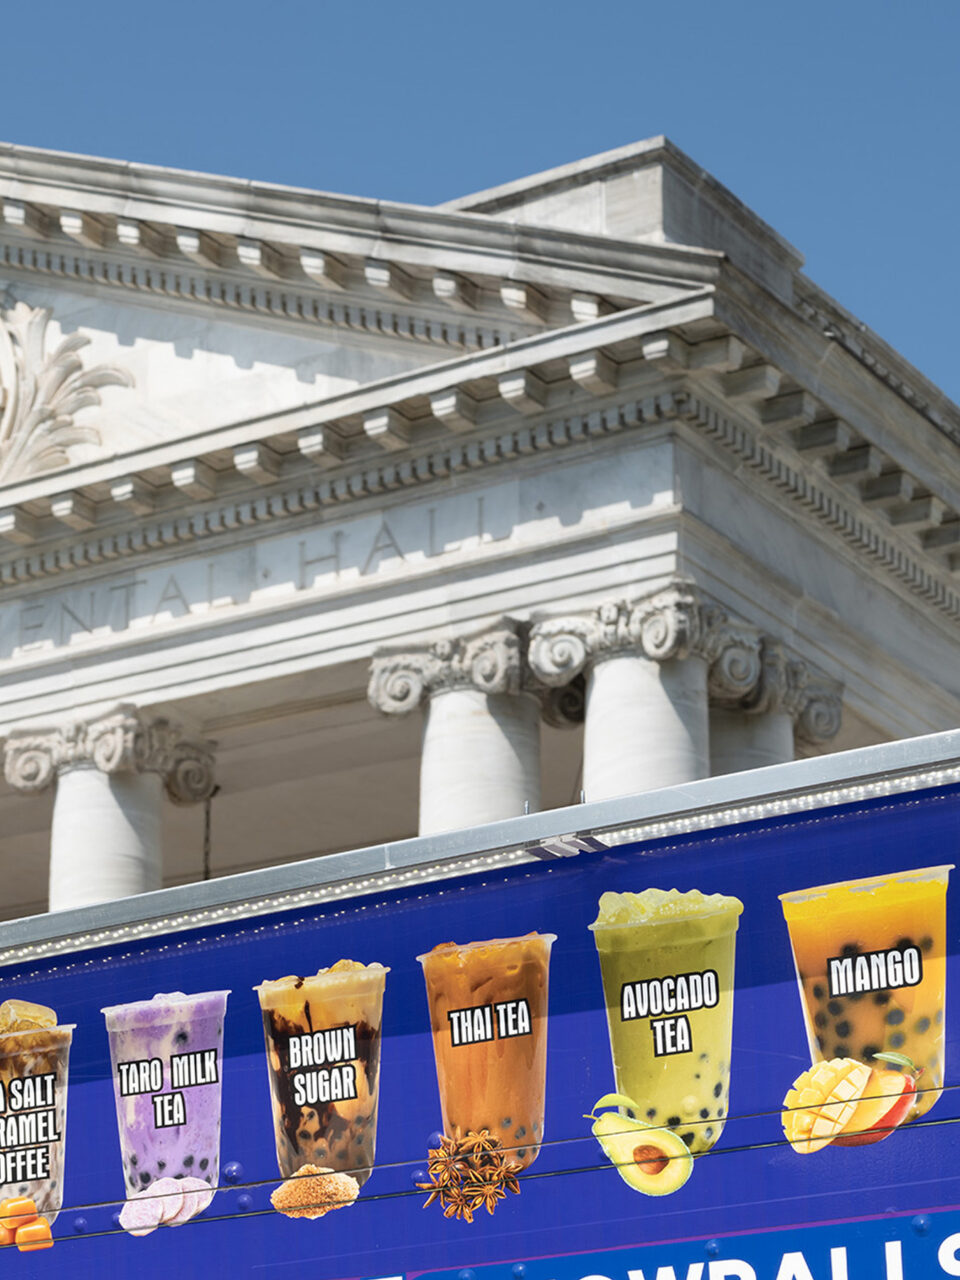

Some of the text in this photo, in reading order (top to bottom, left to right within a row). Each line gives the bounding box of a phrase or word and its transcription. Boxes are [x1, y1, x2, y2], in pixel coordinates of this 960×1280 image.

[298, 497, 508, 590] HALL
[829, 946, 922, 997] MANGO
[621, 971, 718, 1020] AVOCADO
[450, 1000, 531, 1045] THAI TEA
[653, 1016, 691, 1055] TEA
[289, 1027, 356, 1069] BROWN
[11, 1075, 55, 1110] SALT
[118, 1050, 217, 1095] TARO MILK
[294, 1063, 356, 1105] SUGAR
[154, 1095, 185, 1127] TEA
